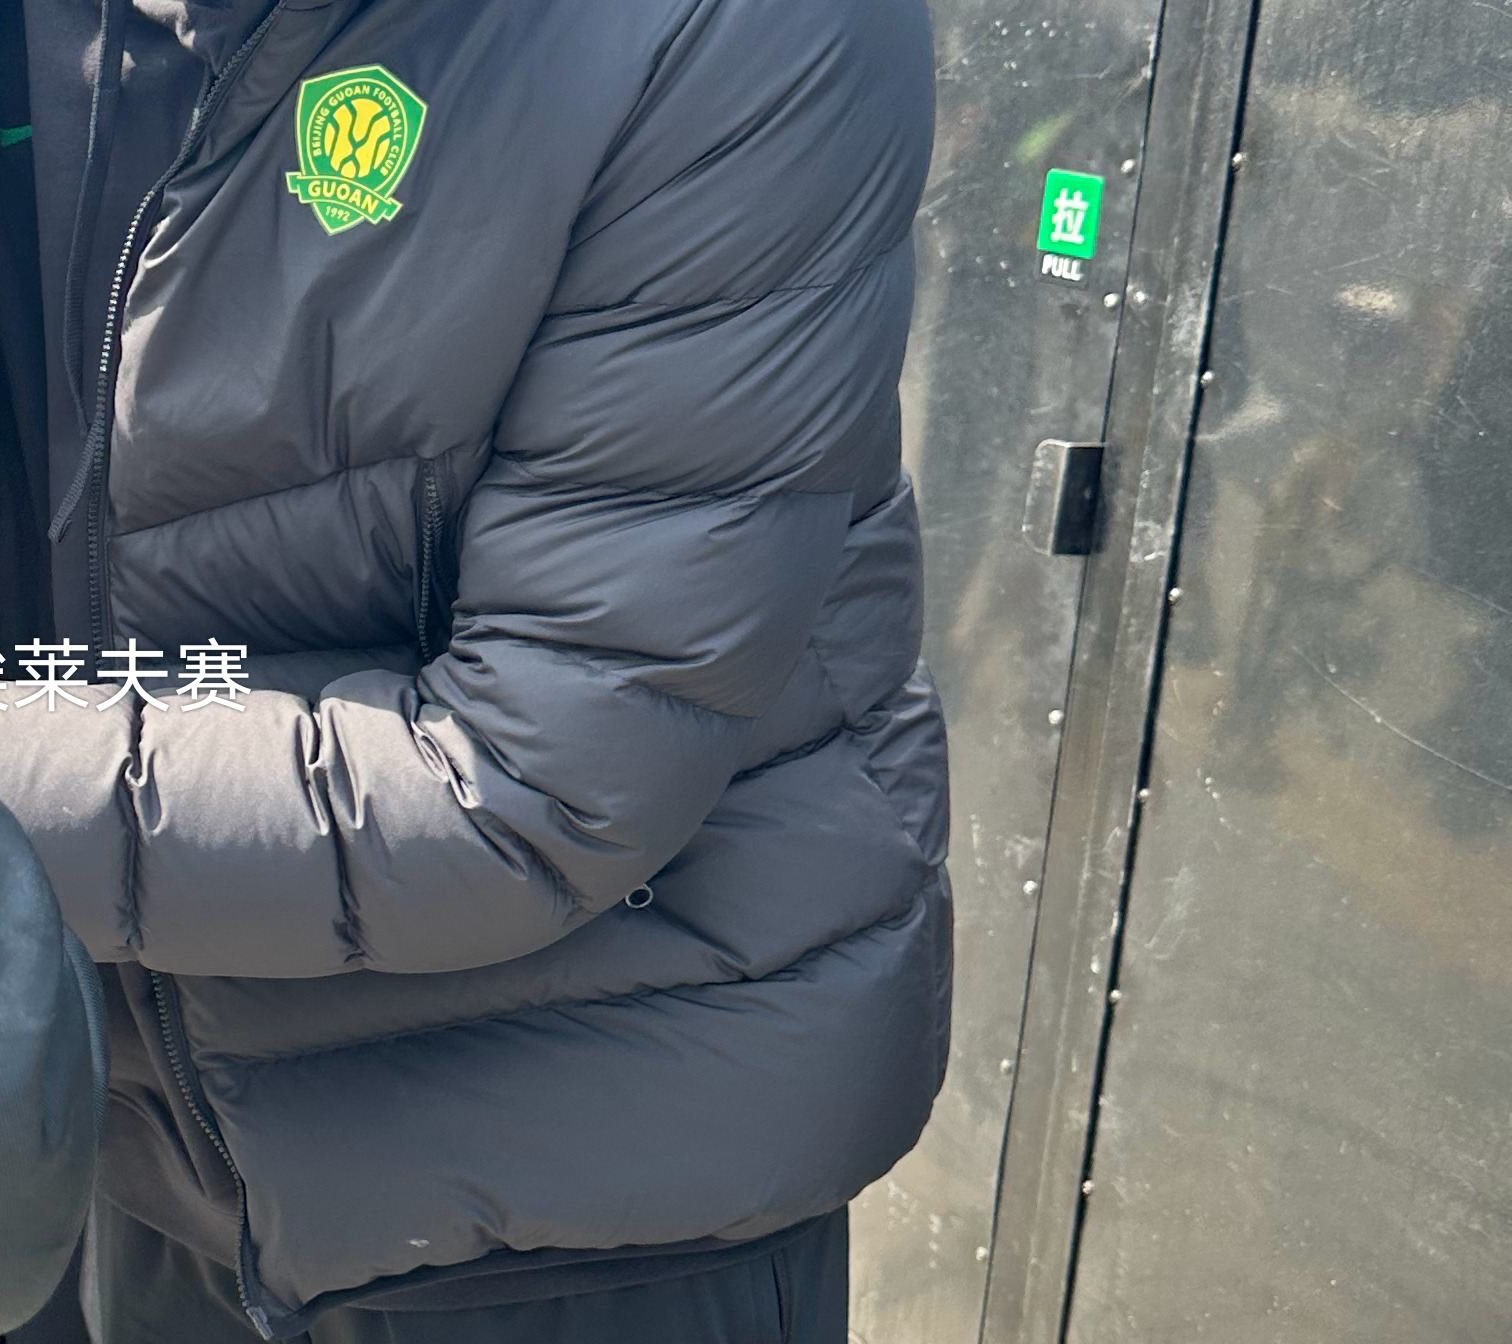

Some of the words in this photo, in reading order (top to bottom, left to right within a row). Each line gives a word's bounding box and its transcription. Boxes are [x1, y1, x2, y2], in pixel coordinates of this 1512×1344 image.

[328, 85, 371, 107] GUOAN
[373, 87, 402, 141] FOOTBALL
[312, 107, 330, 157] BEIJING
[380, 145, 399, 176] CLUB
[308, 180, 379, 215] GUOAN
[325, 205, 350, 222] 1992
[1050, 187, 1089, 245] 拉
[1041, 253, 1085, 281] PULL
